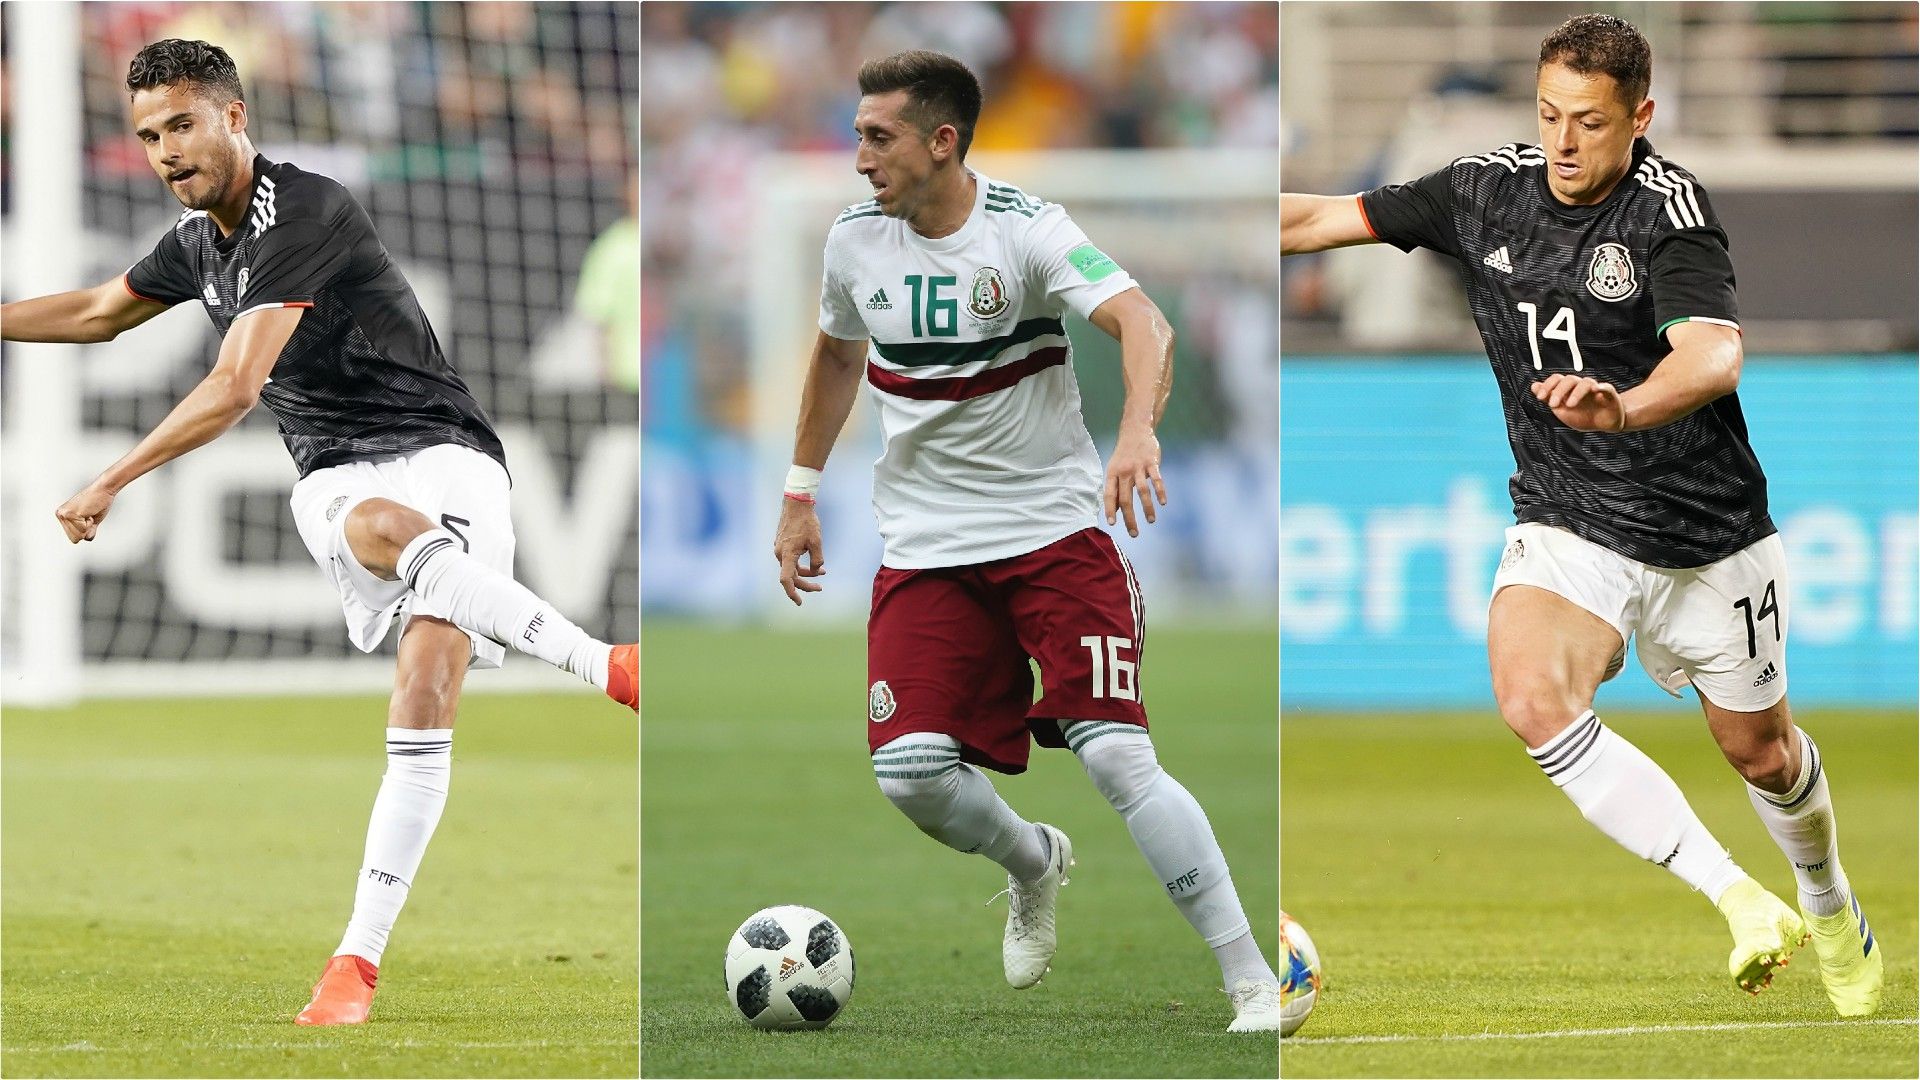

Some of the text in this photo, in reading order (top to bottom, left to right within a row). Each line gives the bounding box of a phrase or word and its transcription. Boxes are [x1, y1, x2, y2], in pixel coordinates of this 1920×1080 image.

[1483, 257, 1513, 274] adidas
[866, 302, 893, 310] adidas
[904, 274, 958, 337] 16
[1517, 302, 1583, 371] 14
[523, 611, 545, 643] FMF
[1734, 579, 1780, 659] 14
[1081, 635, 1136, 701] 16
[1753, 670, 1779, 687] adidas
[1795, 857, 1828, 872] FMF
[369, 869, 400, 886] FMF
[1166, 867, 1199, 895] FMF
[779, 961, 805, 982] adidas
